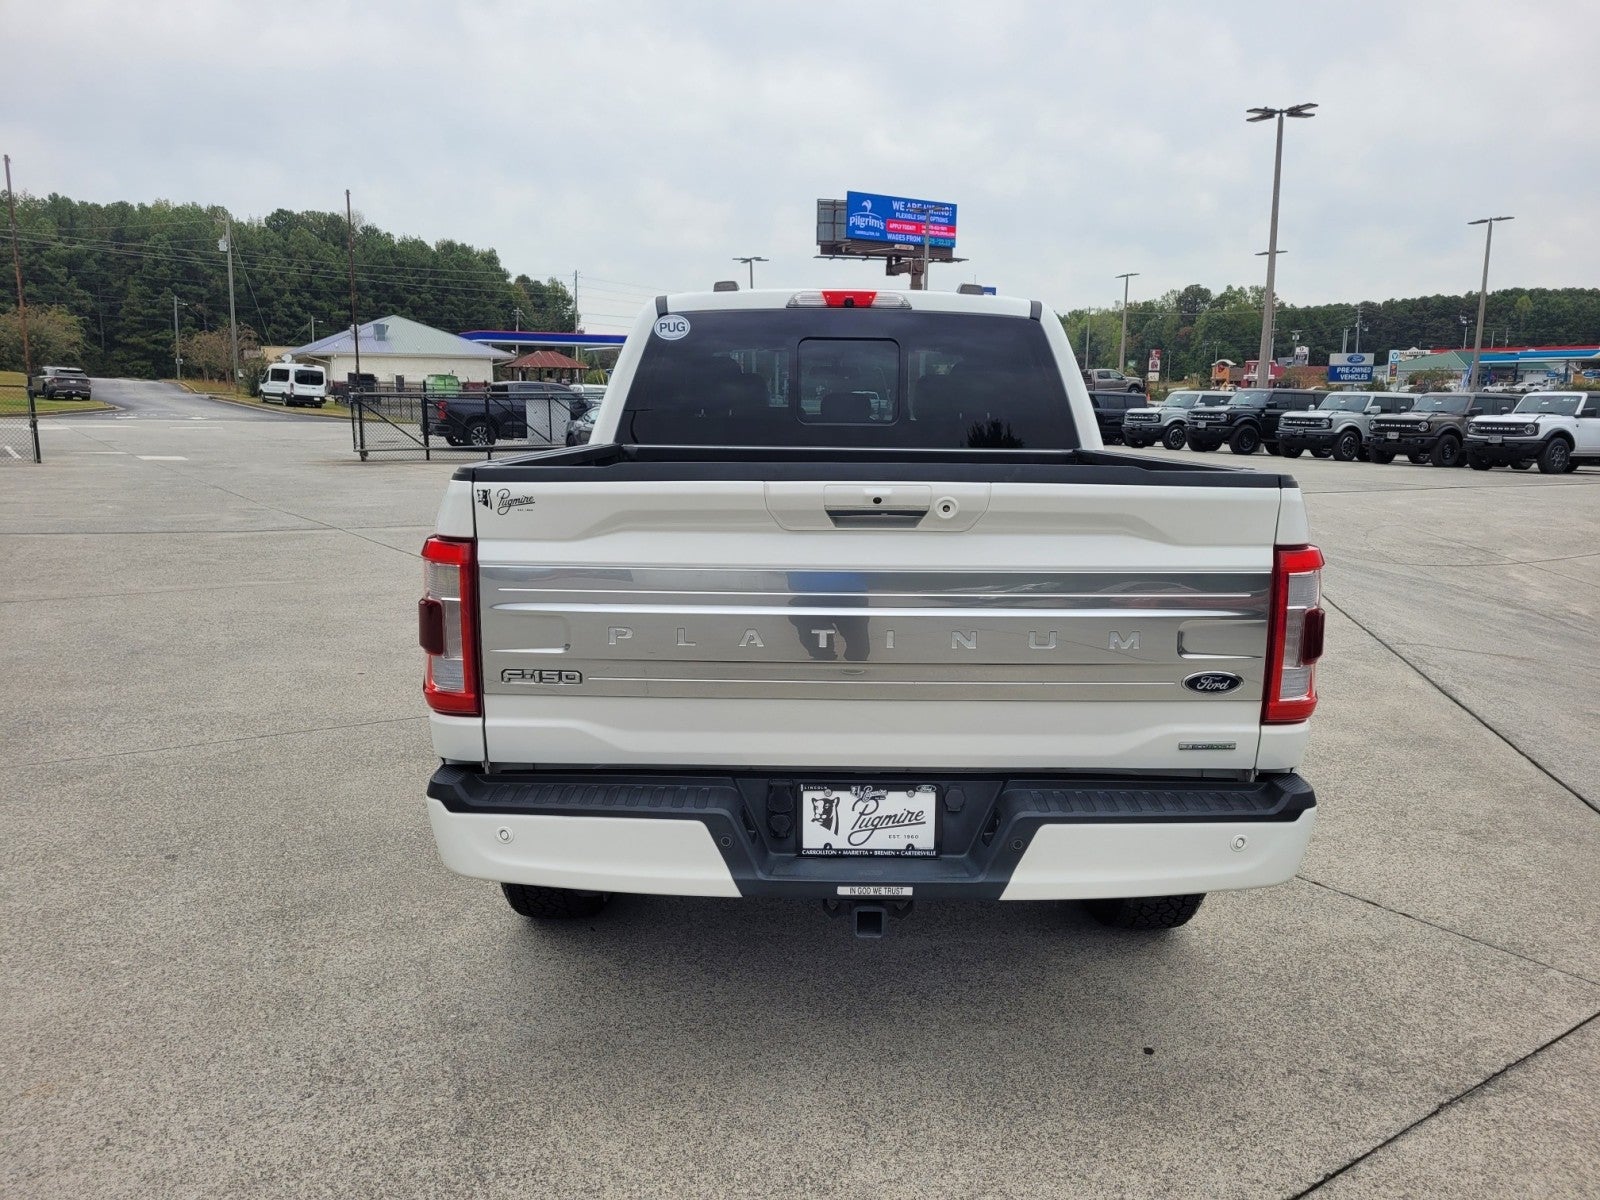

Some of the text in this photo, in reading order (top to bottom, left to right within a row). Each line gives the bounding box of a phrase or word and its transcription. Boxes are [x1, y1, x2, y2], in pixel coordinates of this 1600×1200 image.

[892, 200, 905, 211] WE
[886, 233, 906, 241] WAGES
[906, 235, 921, 243] FROM
[660, 322, 686, 332] PUG
[1336, 366, 1372, 374] PRE-OWNED
[497, 488, 535, 515] Pugmire
[607, 626, 1141, 650] PLATINUM
[501, 668, 582, 684] F-150
[1196, 676, 1231, 690] Ford
[847, 798, 927, 847] Pugmire
[849, 886, 904, 895] IN GOD WE TRUST
